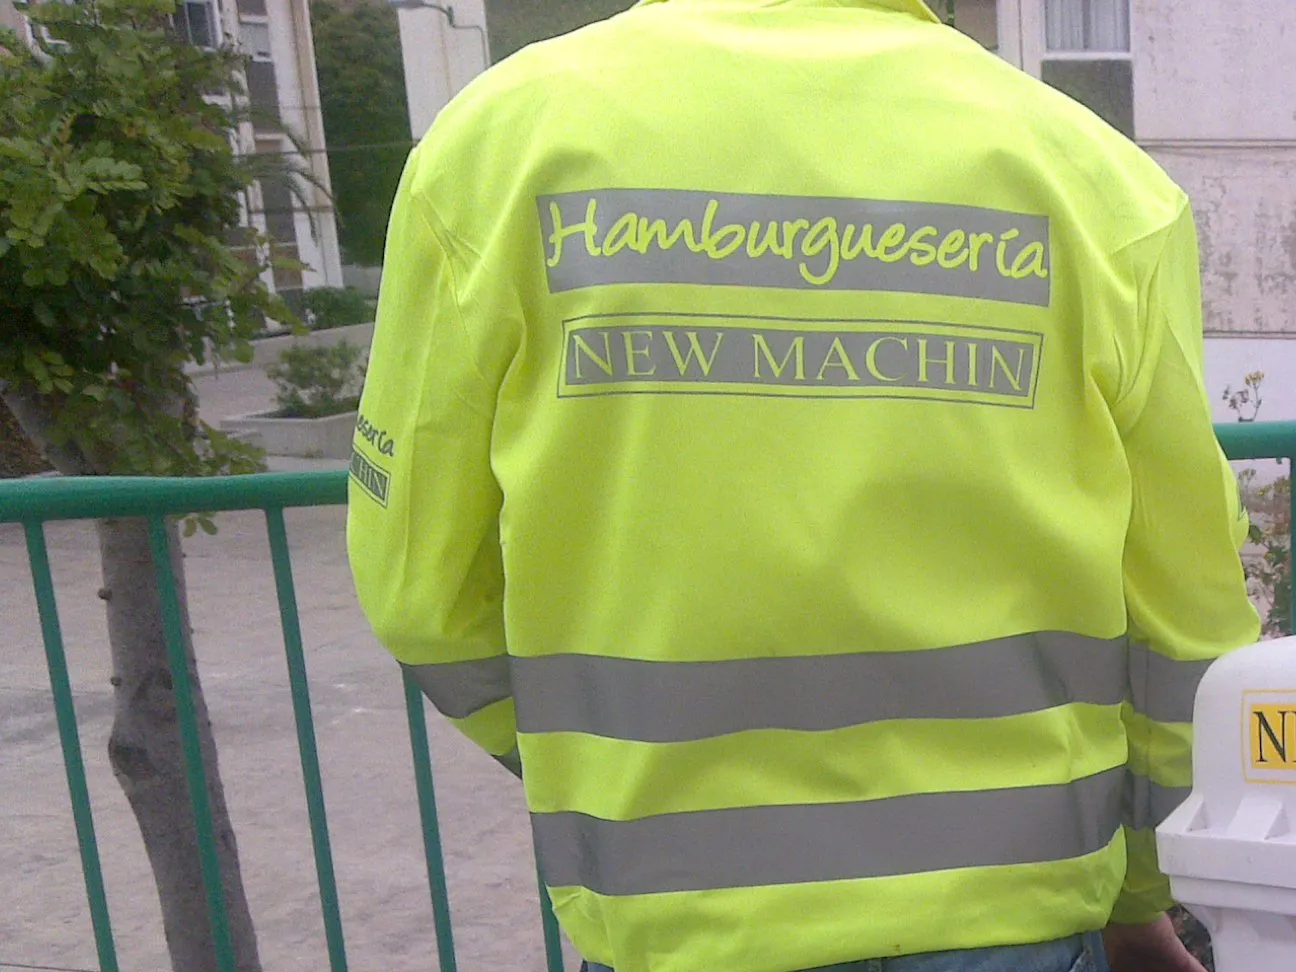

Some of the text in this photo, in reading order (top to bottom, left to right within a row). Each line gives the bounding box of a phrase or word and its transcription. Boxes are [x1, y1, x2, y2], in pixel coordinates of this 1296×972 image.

[547, 198, 1048, 285] Hamburguesería
[572, 330, 1026, 392] NEW MACHIN
